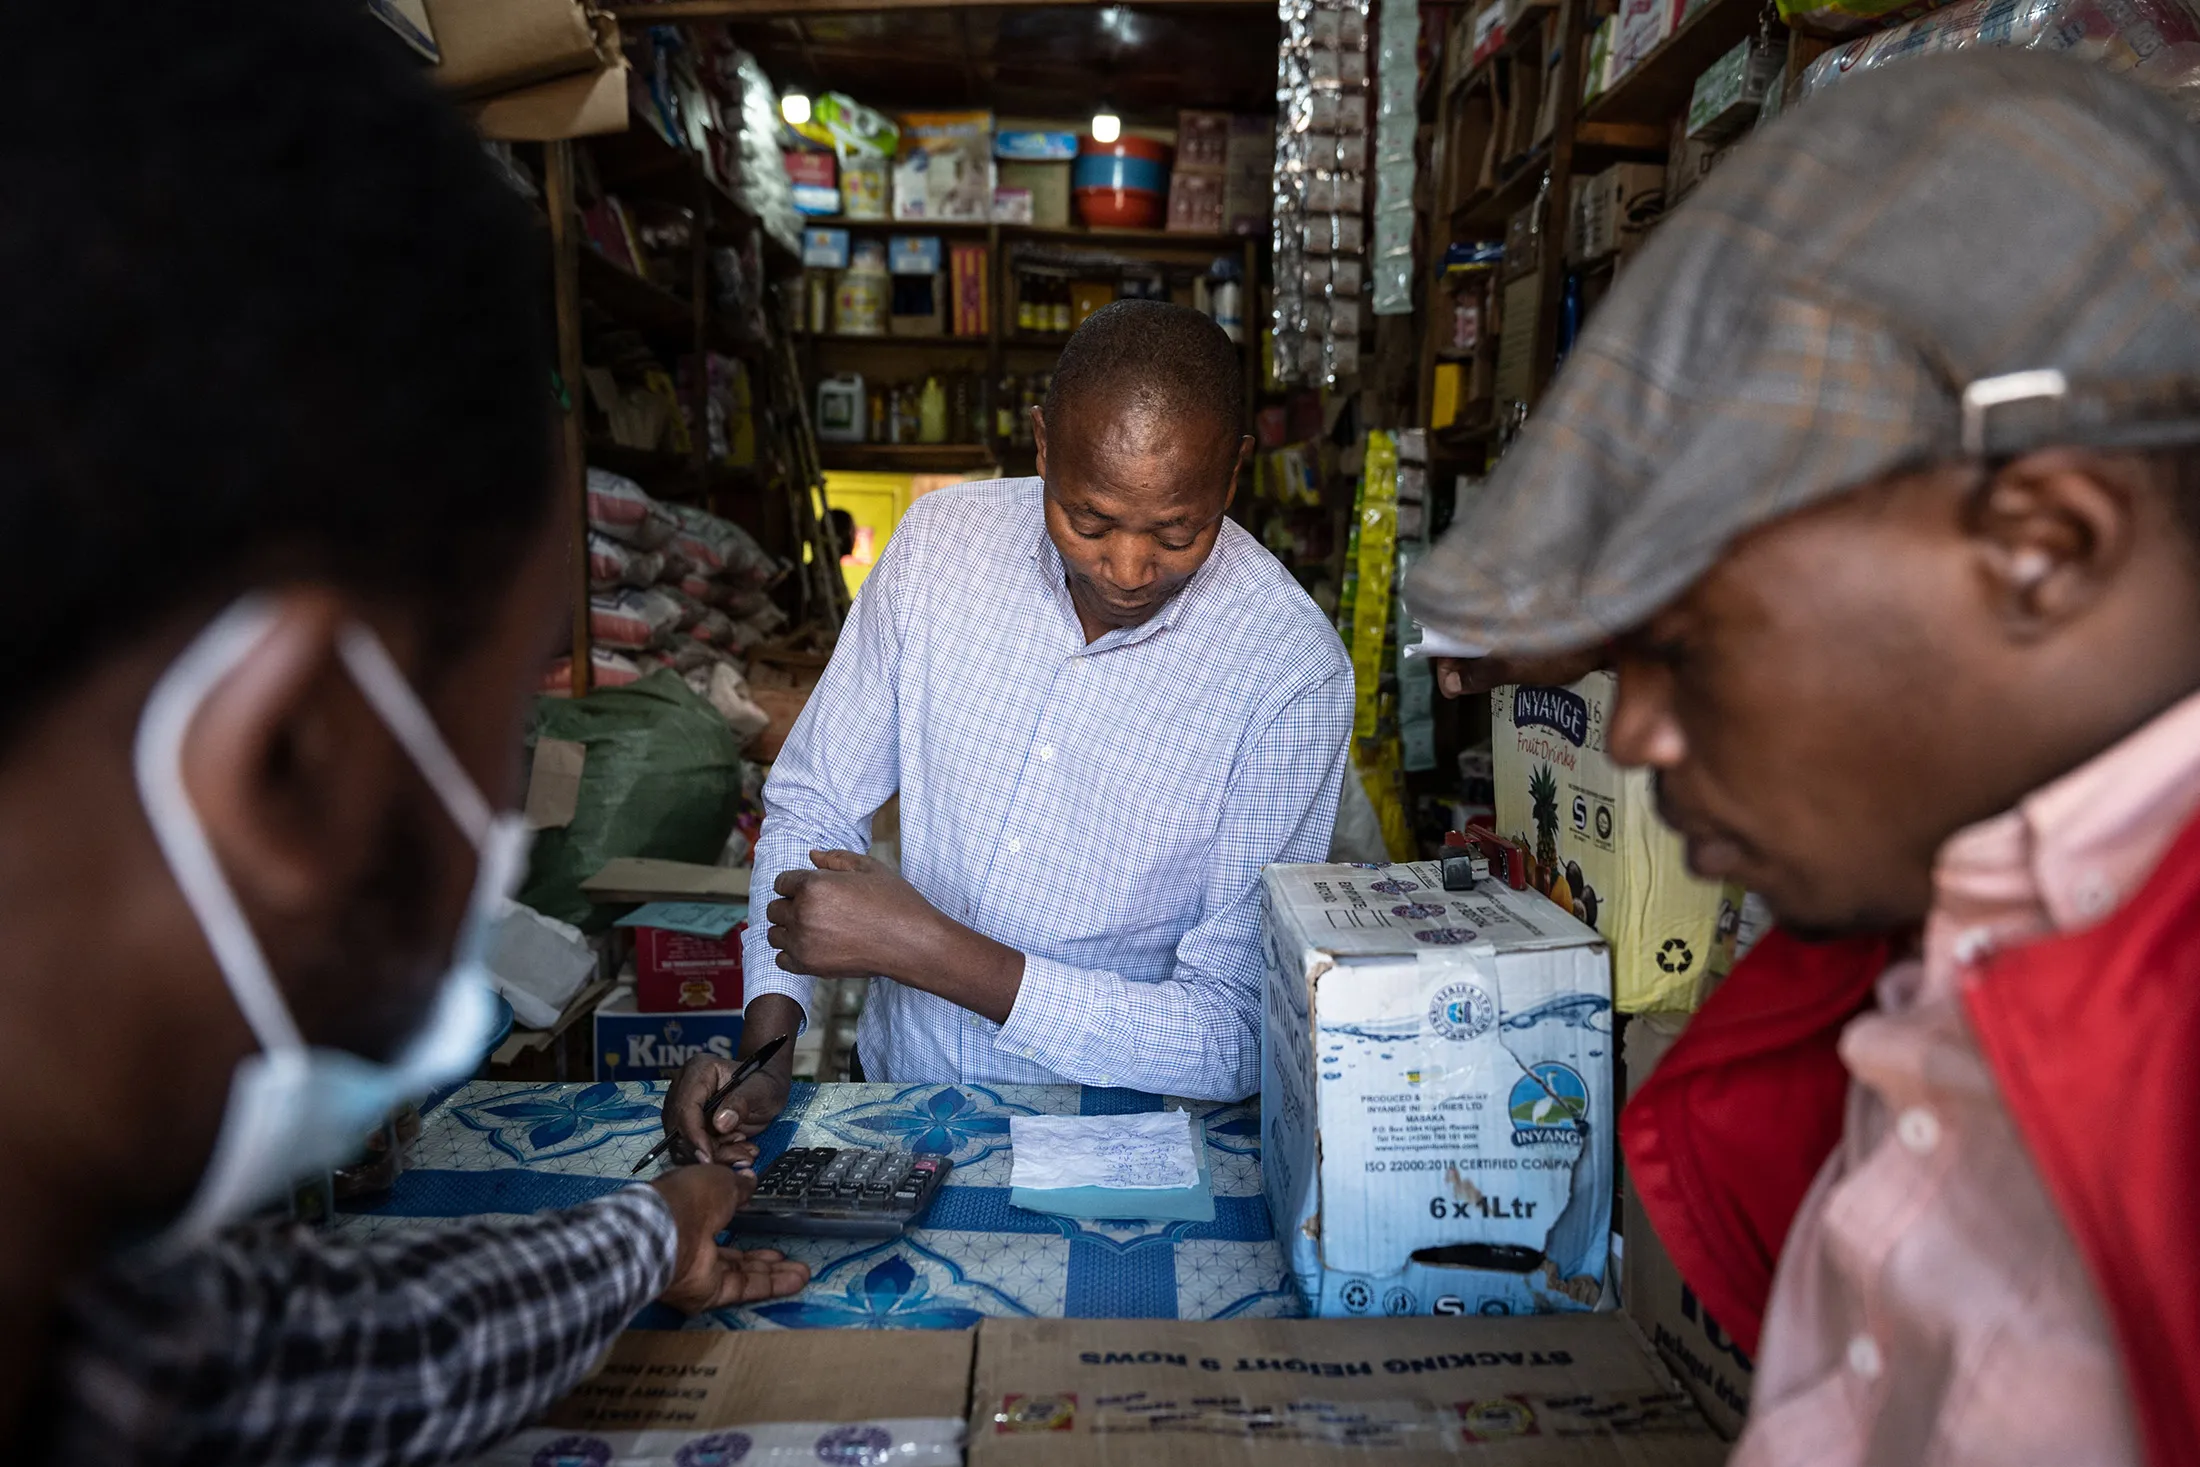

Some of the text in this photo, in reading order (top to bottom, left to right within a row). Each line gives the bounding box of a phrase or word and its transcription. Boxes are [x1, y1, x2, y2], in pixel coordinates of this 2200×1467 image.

[1516, 690, 1582, 740] INYANGE
[1516, 731, 1578, 773] Fruit Drinks
[1360, 1093, 1412, 1103] PRODUCED
[1414, 1093, 1421, 1102] &
[1367, 1105, 1406, 1113] INYANGE
[1466, 1101, 1483, 1111] LTD
[1406, 1114, 1445, 1122] MASAKA
[1449, 1123, 1479, 1132] Rwanda
[1516, 1129, 1582, 1146] INYANG
[1365, 1161, 1386, 1172] ISO
[1459, 1158, 1518, 1170] CERTIFIED
[1521, 1157, 1573, 1171] COMPA
[1429, 1197, 1447, 1219] 6
[1453, 1202, 1471, 1219] x
[1078, 1350, 1187, 1368] ROWS
[1234, 1353, 1373, 1377] HEIGHT
[1382, 1348, 1574, 1375] STACKING
